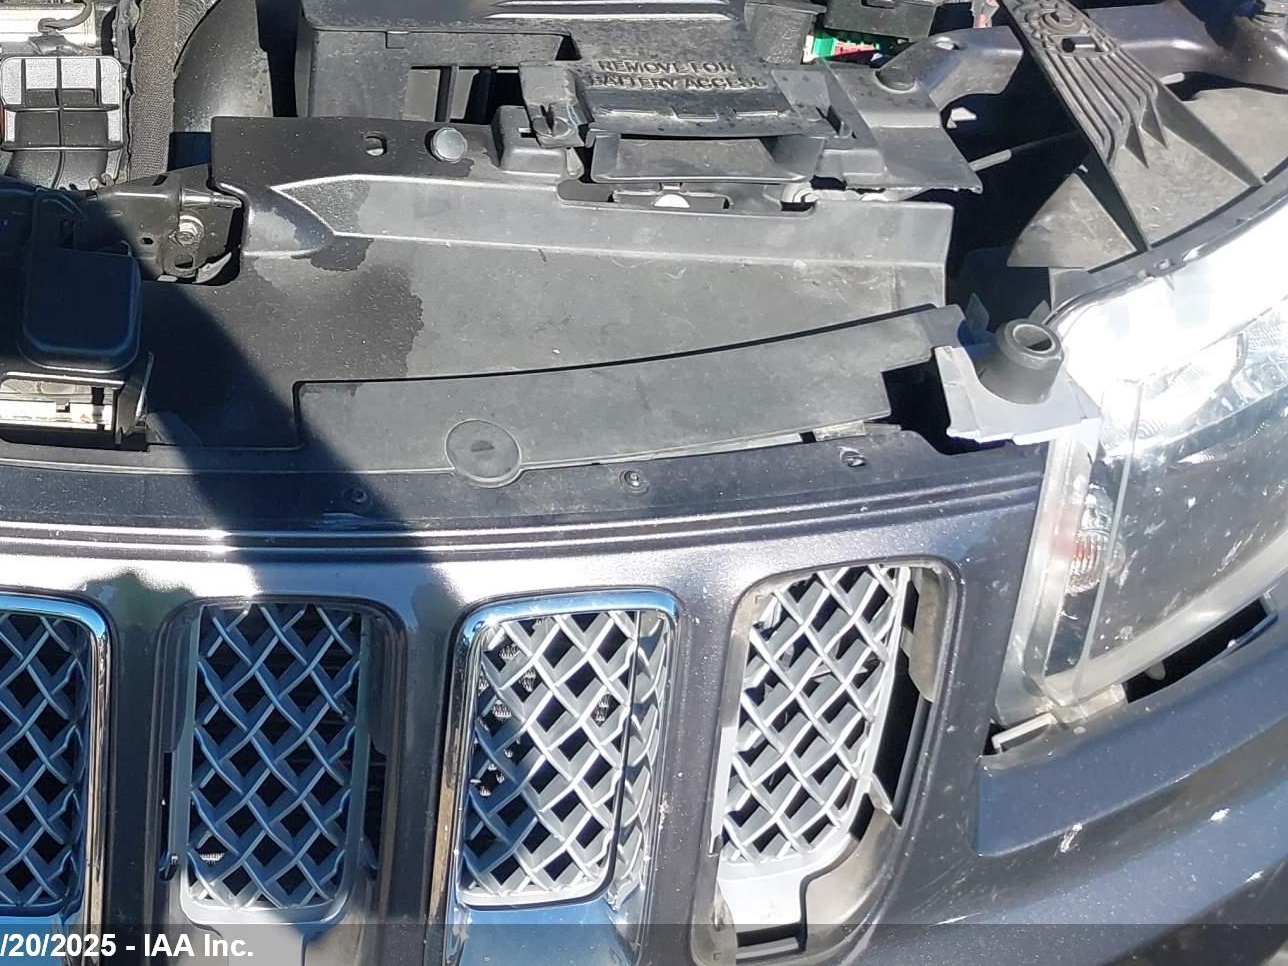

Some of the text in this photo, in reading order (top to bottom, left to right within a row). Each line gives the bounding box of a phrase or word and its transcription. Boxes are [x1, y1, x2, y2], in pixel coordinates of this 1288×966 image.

[597, 59, 736, 74] REMOVE FOR
[590, 72, 677, 90] BATTERY
